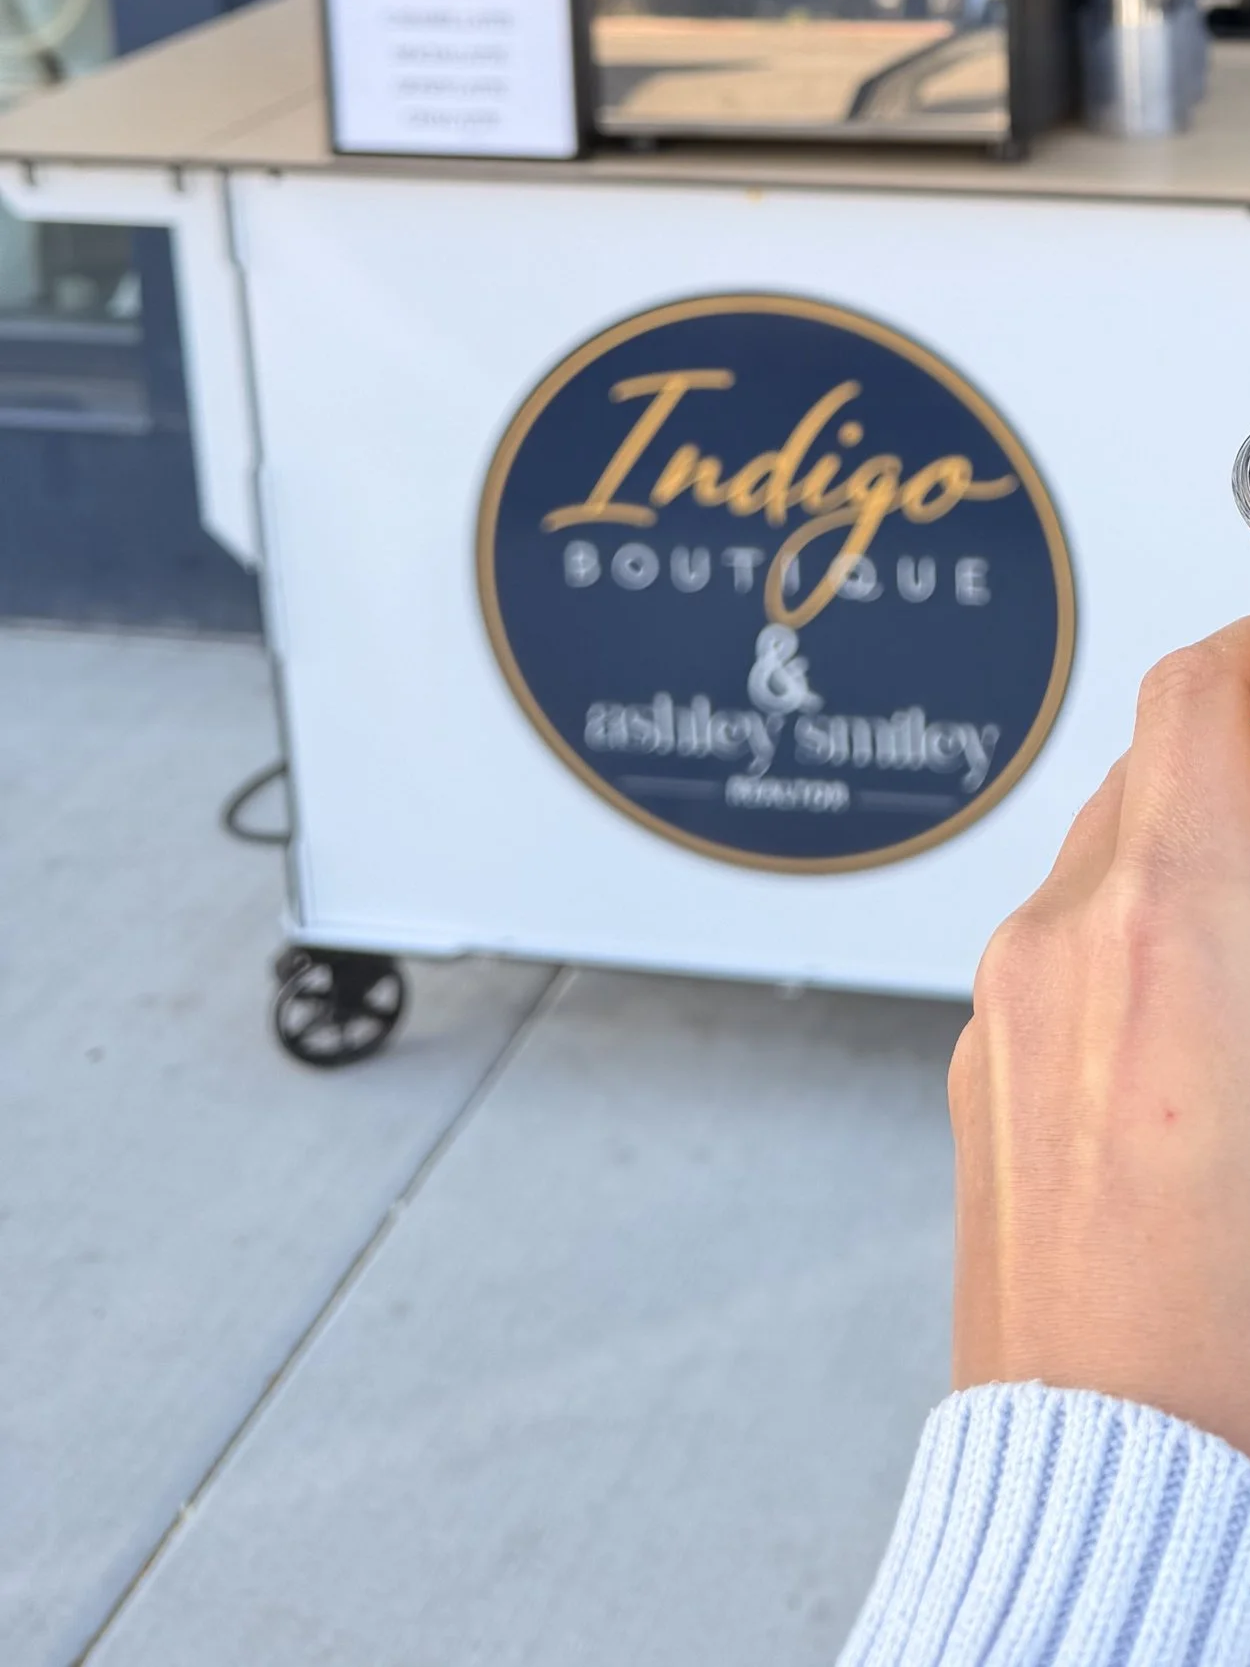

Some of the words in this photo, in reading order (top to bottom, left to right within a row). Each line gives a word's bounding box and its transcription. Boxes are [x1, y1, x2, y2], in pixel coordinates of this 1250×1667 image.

[540, 367, 1020, 631] Indigo
[562, 539, 994, 607] BOUTIQUE
[747, 621, 824, 714] &
[583, 691, 786, 780] ashley
[794, 705, 1001, 795] smiley
